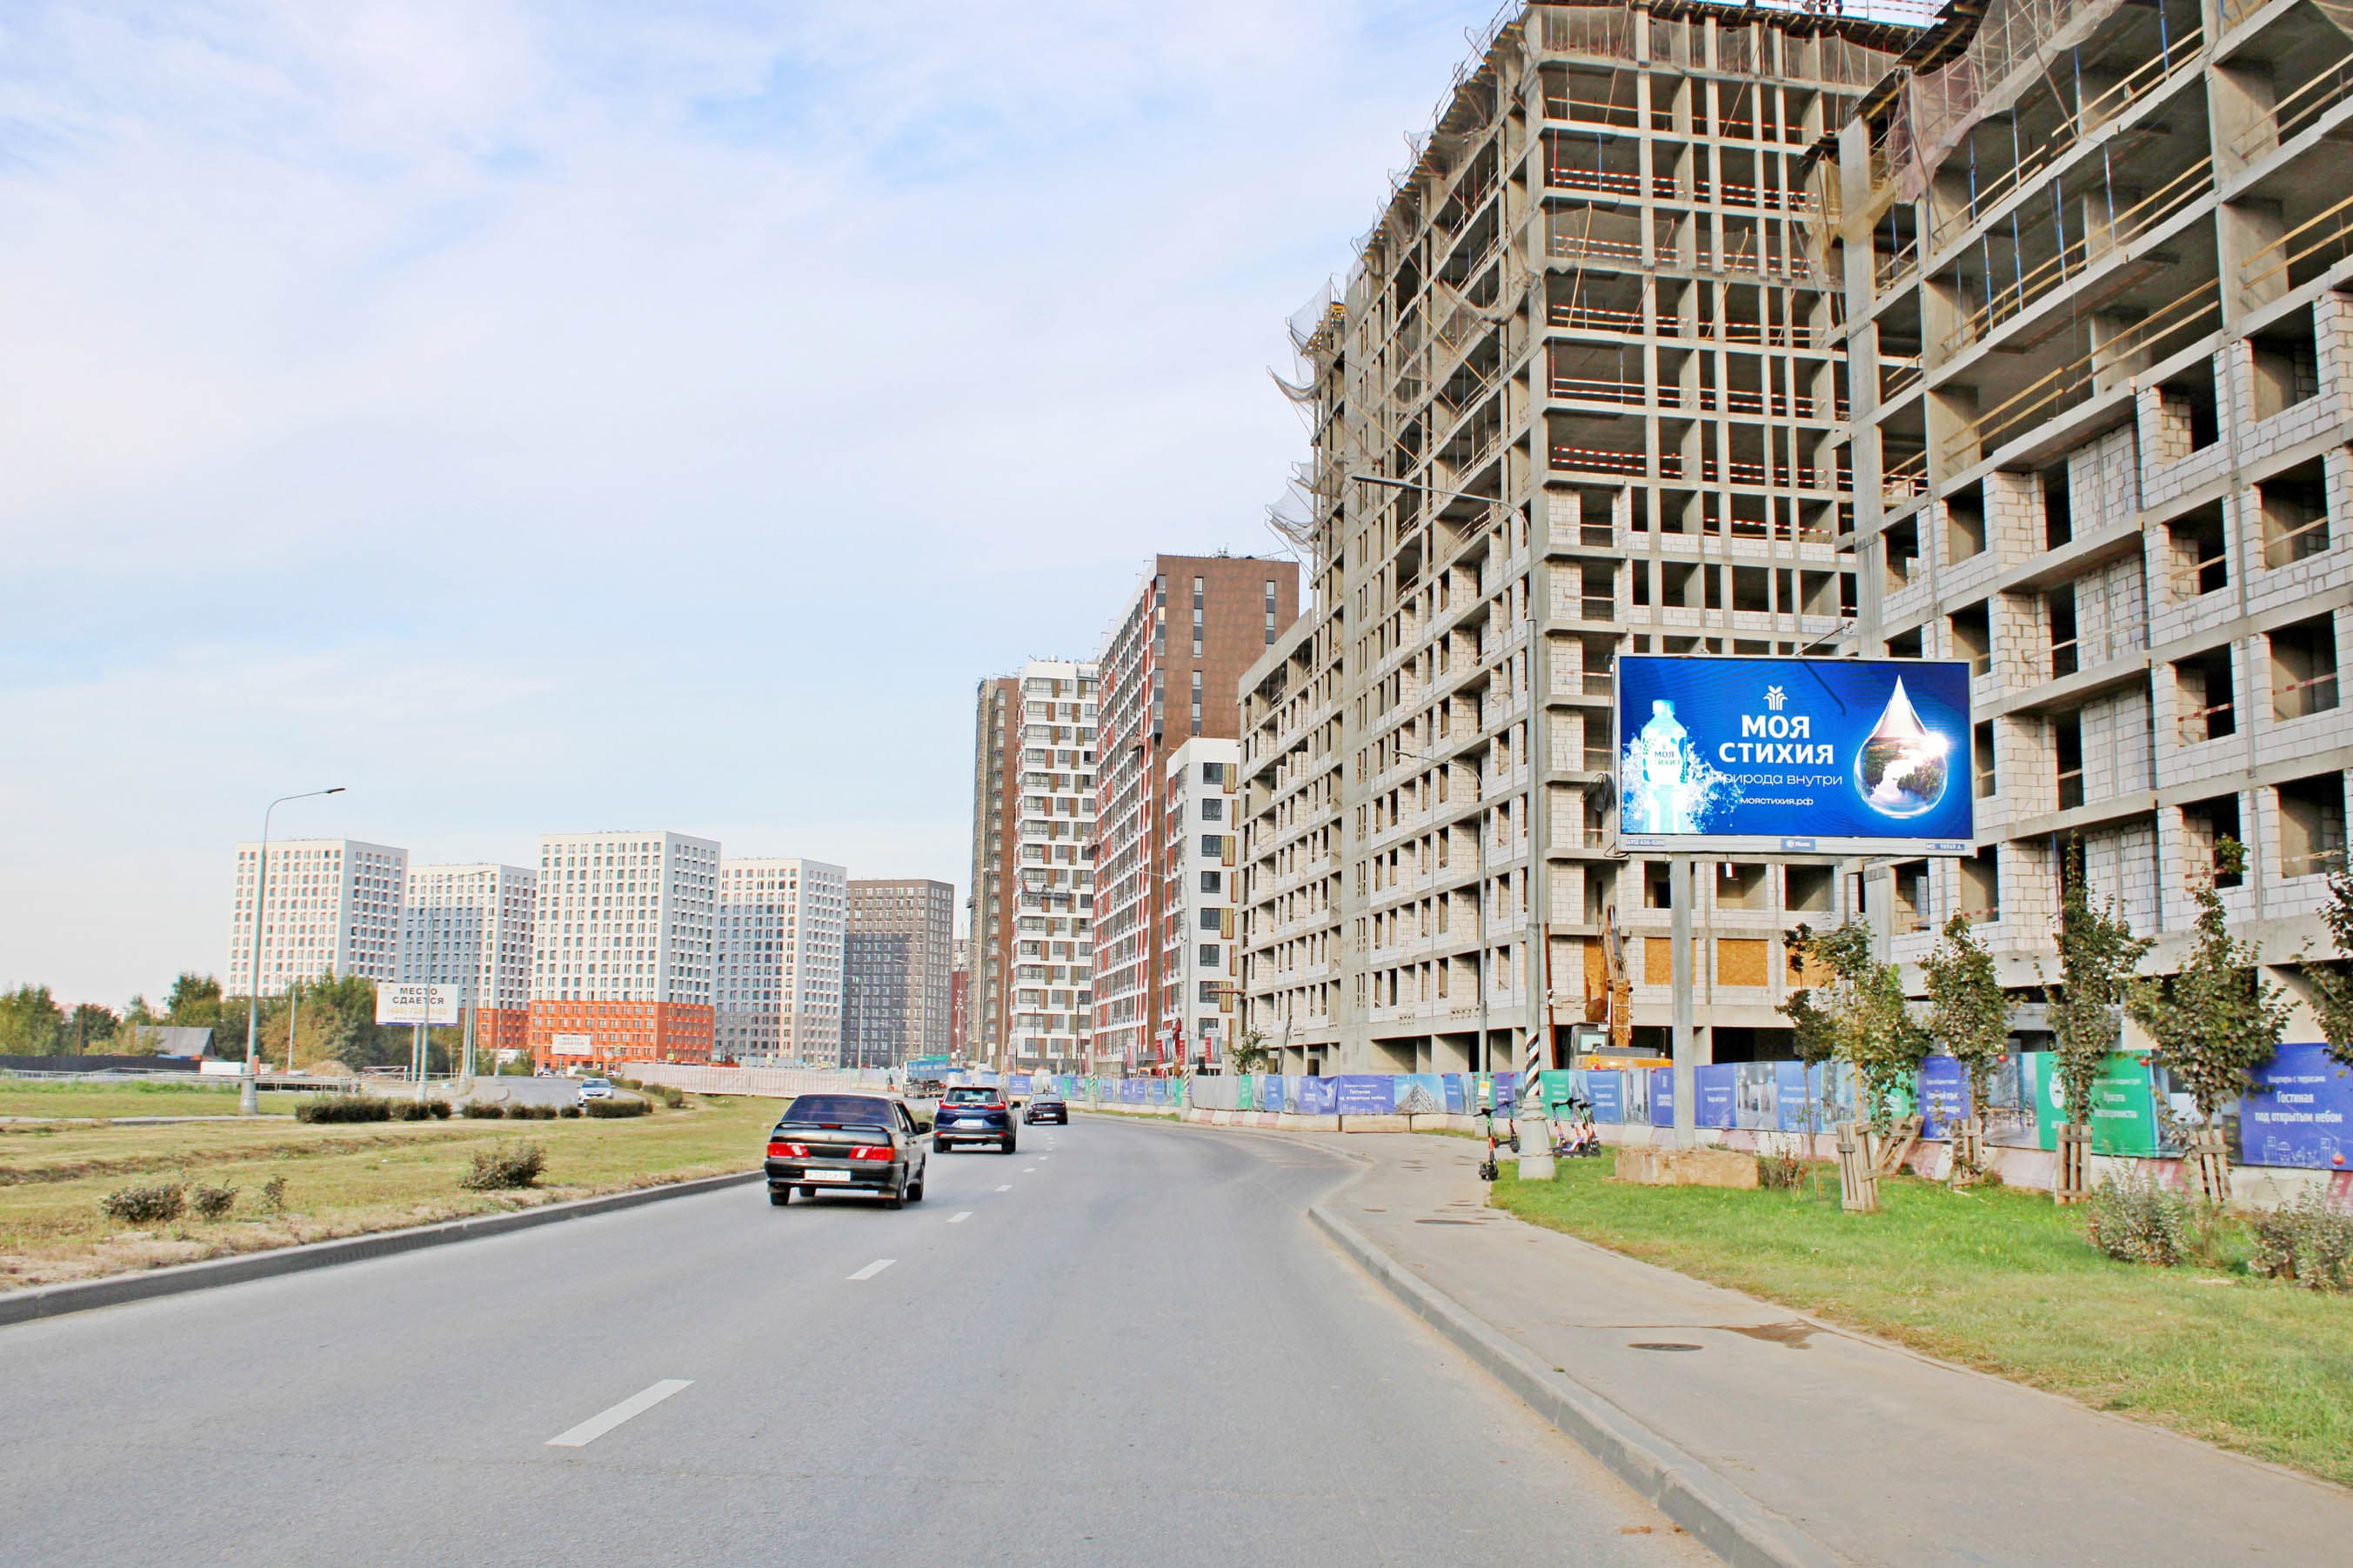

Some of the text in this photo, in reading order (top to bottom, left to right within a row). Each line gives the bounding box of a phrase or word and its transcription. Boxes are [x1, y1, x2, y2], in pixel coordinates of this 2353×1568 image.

[1741, 714, 1810, 738] МОЯ
[1718, 742, 1835, 764] СТИХИЯ
[1787, 774, 1843, 787] внутри
[1740, 797, 1814, 807] моястихия.рф
[2276, 1091, 2314, 1104] Гостиная
[2254, 1110, 2343, 1124] под открытым небом
